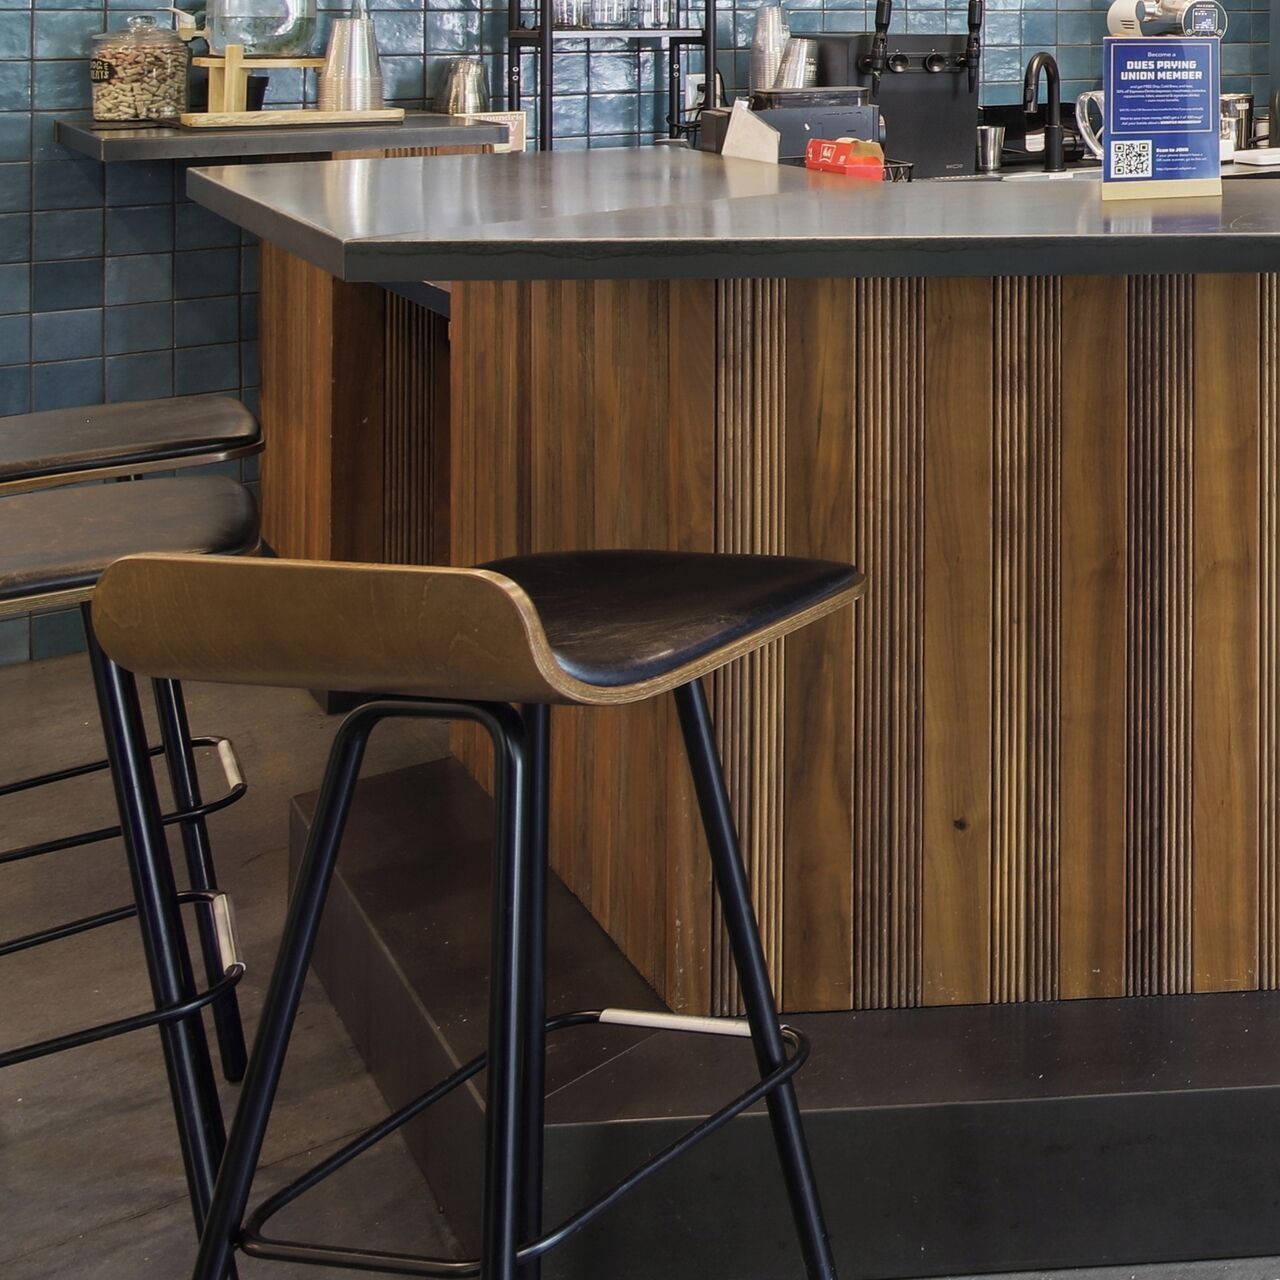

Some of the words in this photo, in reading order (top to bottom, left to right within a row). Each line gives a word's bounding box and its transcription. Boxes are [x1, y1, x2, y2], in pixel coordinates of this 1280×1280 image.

[1126, 60, 1155, 70] DUES
[1156, 60, 1197, 70] PAYING
[1120, 72, 1155, 81] UNION
[1157, 72, 1203, 80] MEMBER
